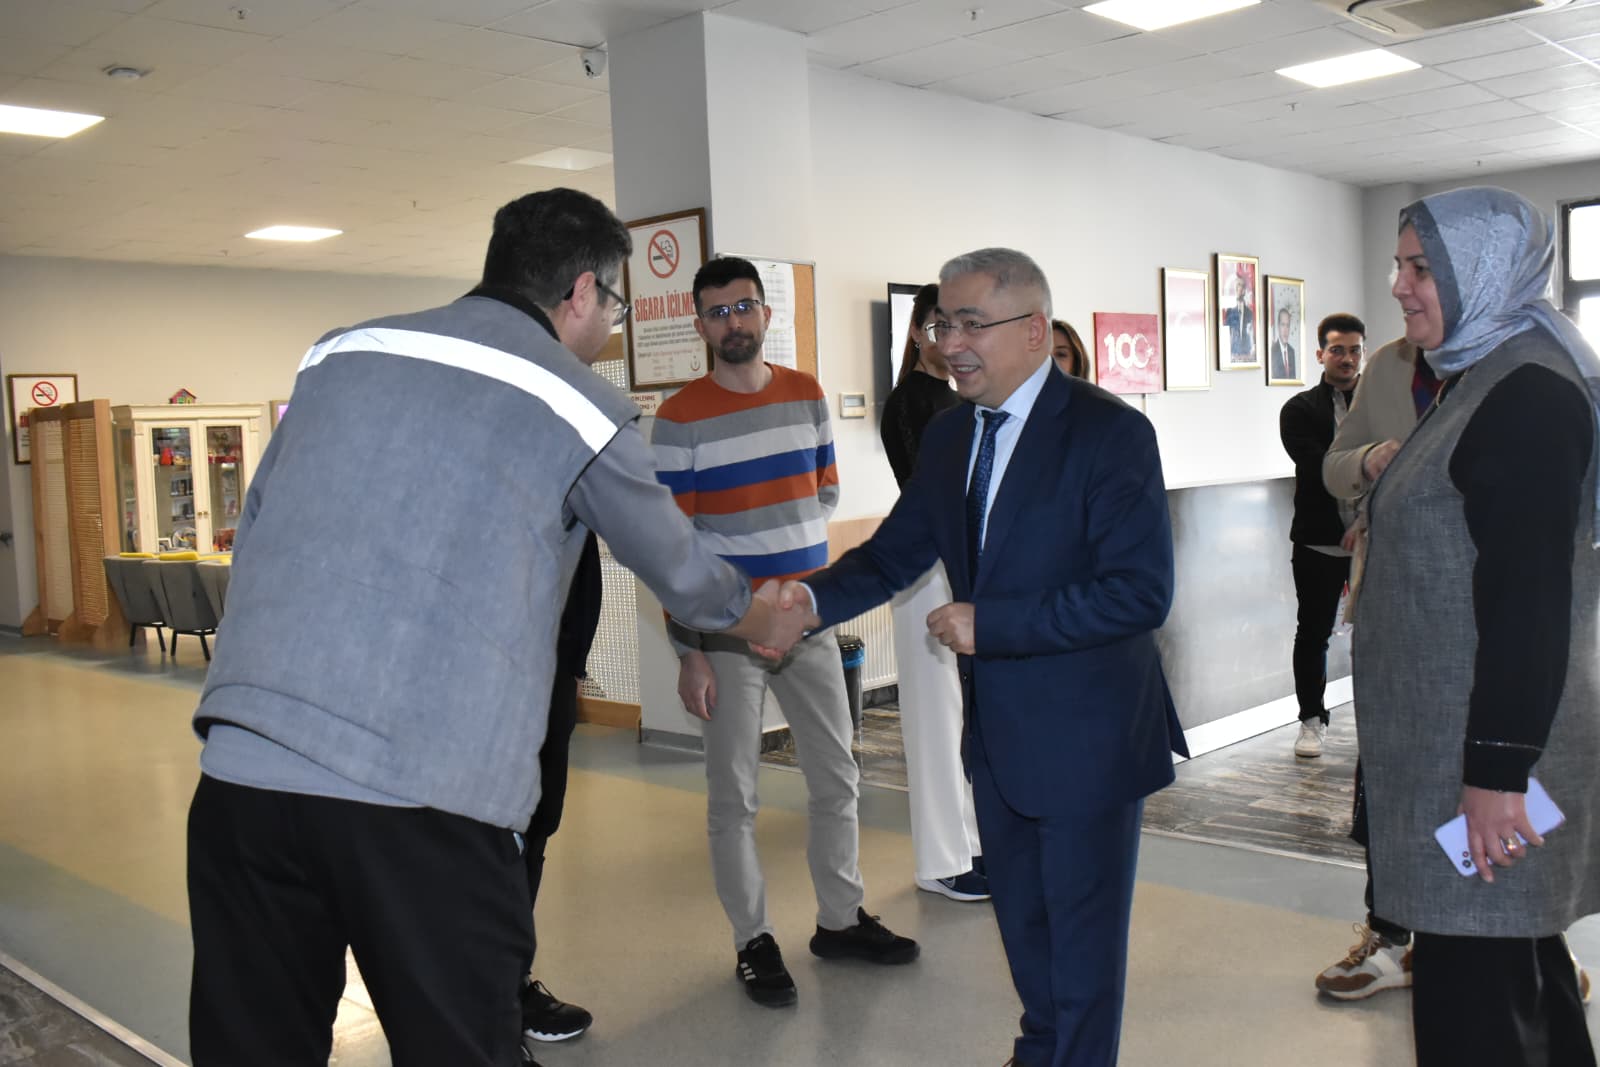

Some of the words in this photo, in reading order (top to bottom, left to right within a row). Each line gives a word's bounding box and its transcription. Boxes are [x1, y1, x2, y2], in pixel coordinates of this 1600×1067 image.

[634, 294, 665, 322] SİGARA
[667, 290, 696, 321] İÇİLME
[1104, 332, 1152, 373] 100
